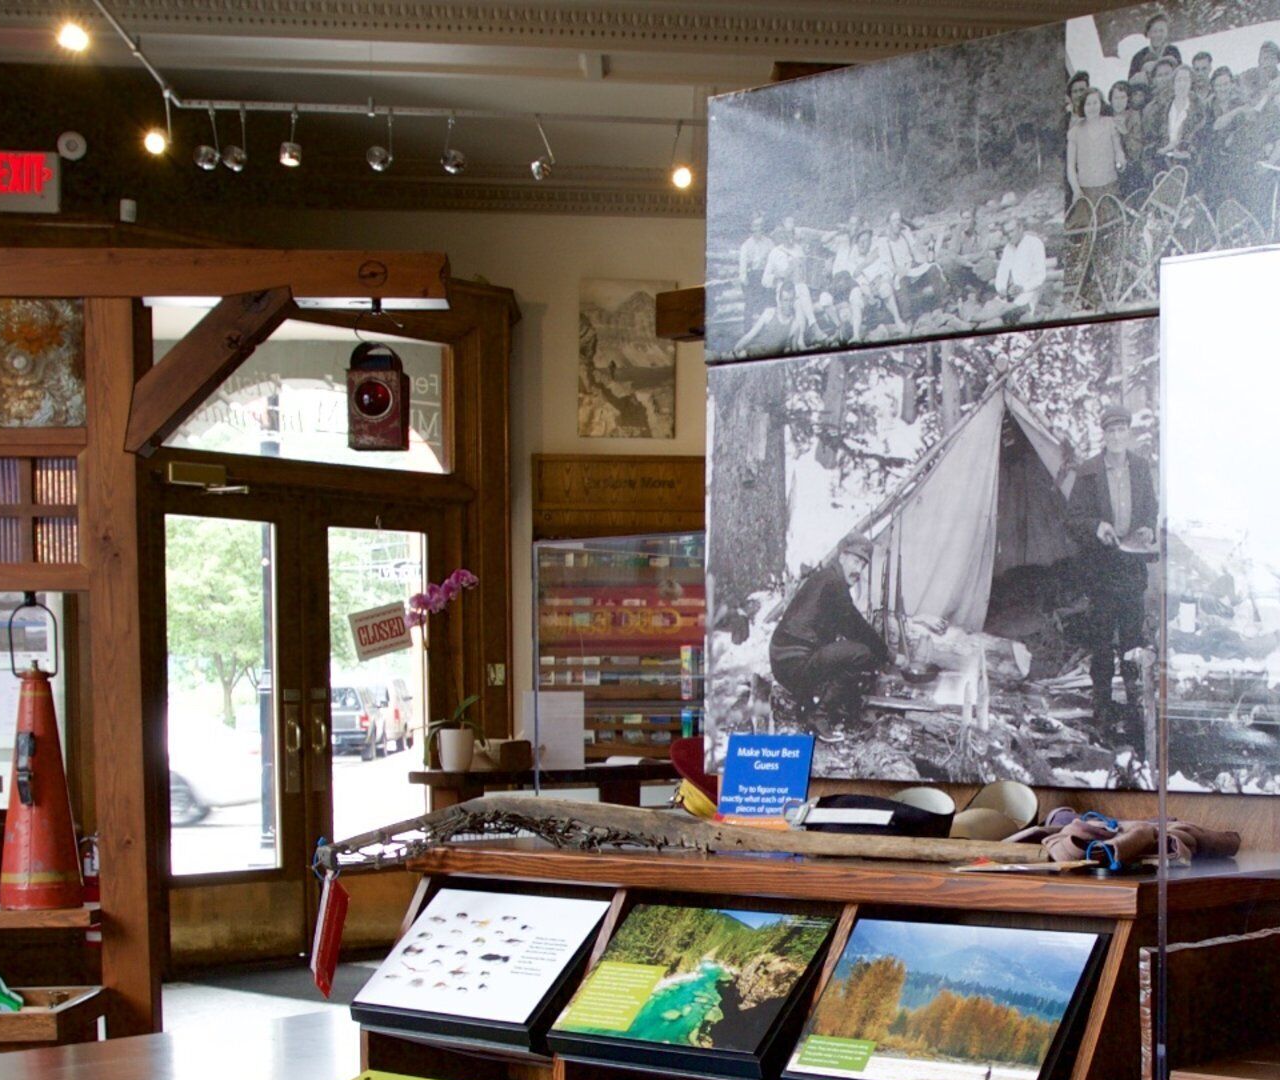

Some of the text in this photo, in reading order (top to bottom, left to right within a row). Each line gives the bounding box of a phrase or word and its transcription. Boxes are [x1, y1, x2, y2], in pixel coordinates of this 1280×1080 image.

[357, 616, 406, 647] CLOSED
[737, 747, 800, 758] Make Your Best
[753, 760, 779, 771] Guess
[738, 785, 748, 794] Try
[757, 785, 776, 795] figure
